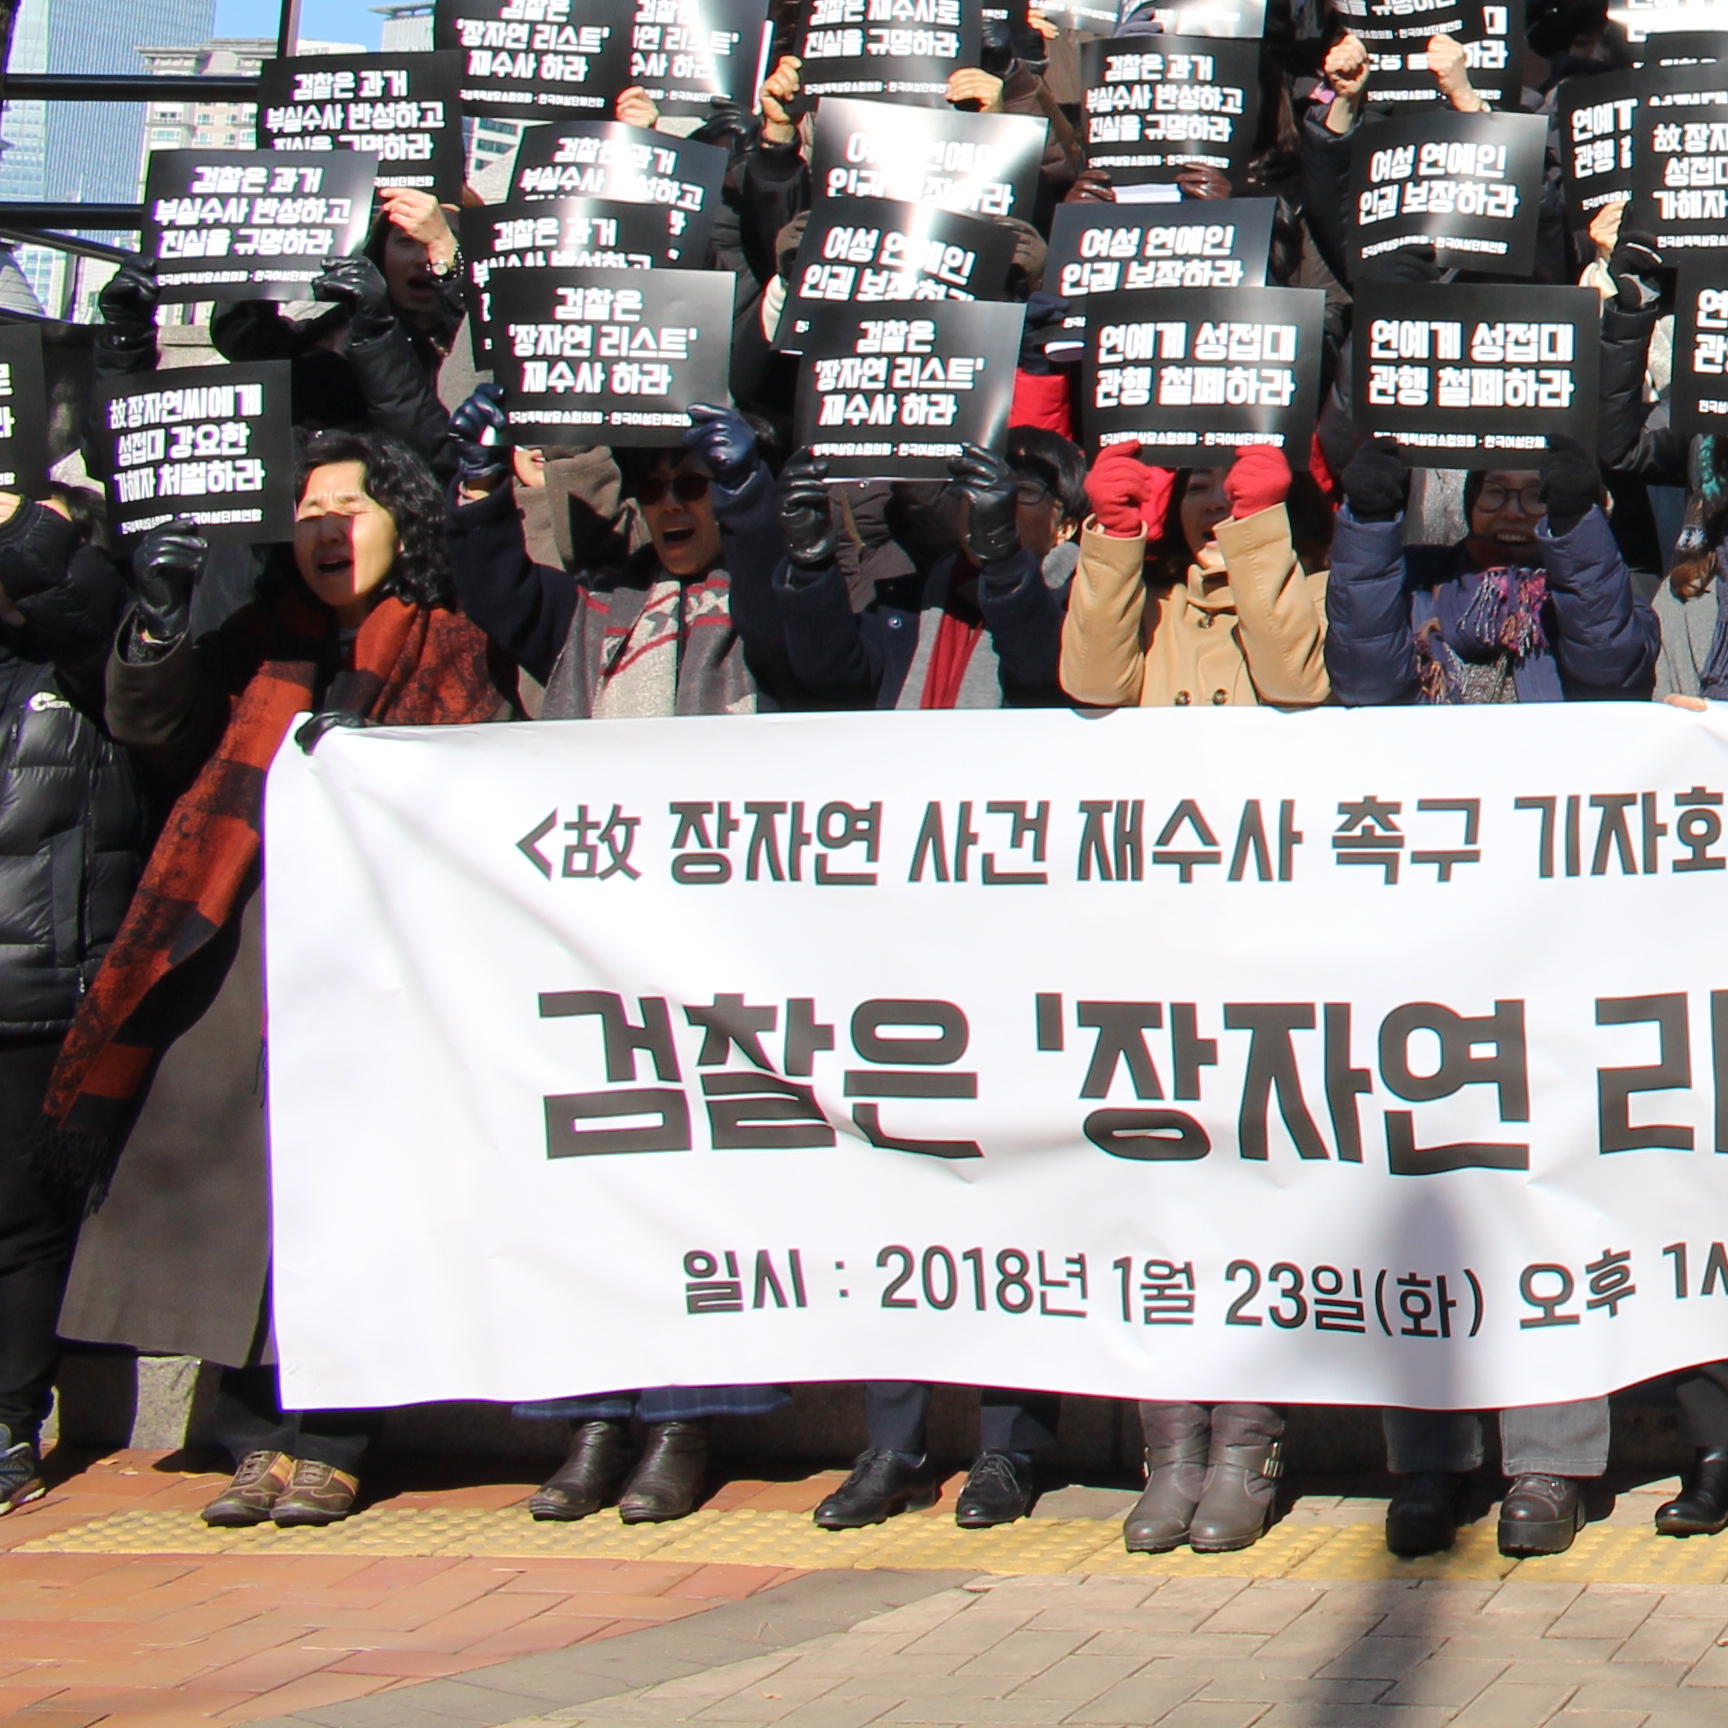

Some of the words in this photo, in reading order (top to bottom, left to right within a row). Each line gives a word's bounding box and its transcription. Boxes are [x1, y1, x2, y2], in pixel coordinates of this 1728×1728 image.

[192, 166, 267, 193] 검찰은
[271, 168, 322, 192] 과거
[155, 198, 249, 225] 부실수사
[252, 198, 351, 224] 반성하고
[1653, 190, 1728, 219] 가해자
[160, 229, 230, 258] 진실을
[235, 228, 333, 255] 규명하라
[556, 288, 642, 321] 검찰은
[1371, 320, 1461, 359] 연예계
[1472, 323, 1573, 362] 성접대
[523, 362, 605, 393] 재수사
[613, 362, 671, 394] 하라
[1370, 365, 1428, 405] 관행
[1439, 367, 1574, 407] 철폐하라
[119, 429, 165, 466] 성접대
[170, 422, 250, 458] 강요한
[114, 467, 155, 502] 가해자
[159, 459, 265, 496] 처벌하라
[670, 801, 882, 886] 장자연
[908, 801, 1049, 885] 사건
[1077, 800, 1302, 883] 재수사
[1332, 796, 1480, 885] 촉구
[538, 990, 984, 1159] 검찰은
[1036, 993, 1529, 1176] '장자연
[684, 1249, 807, 1314] 일시
[877, 1245, 1087, 1318] 2018년
[1113, 1257, 1195, 1325] 1월
[1226, 1260, 1483, 1340] 23일(화)
[1520, 1249, 1636, 1329] 오후
